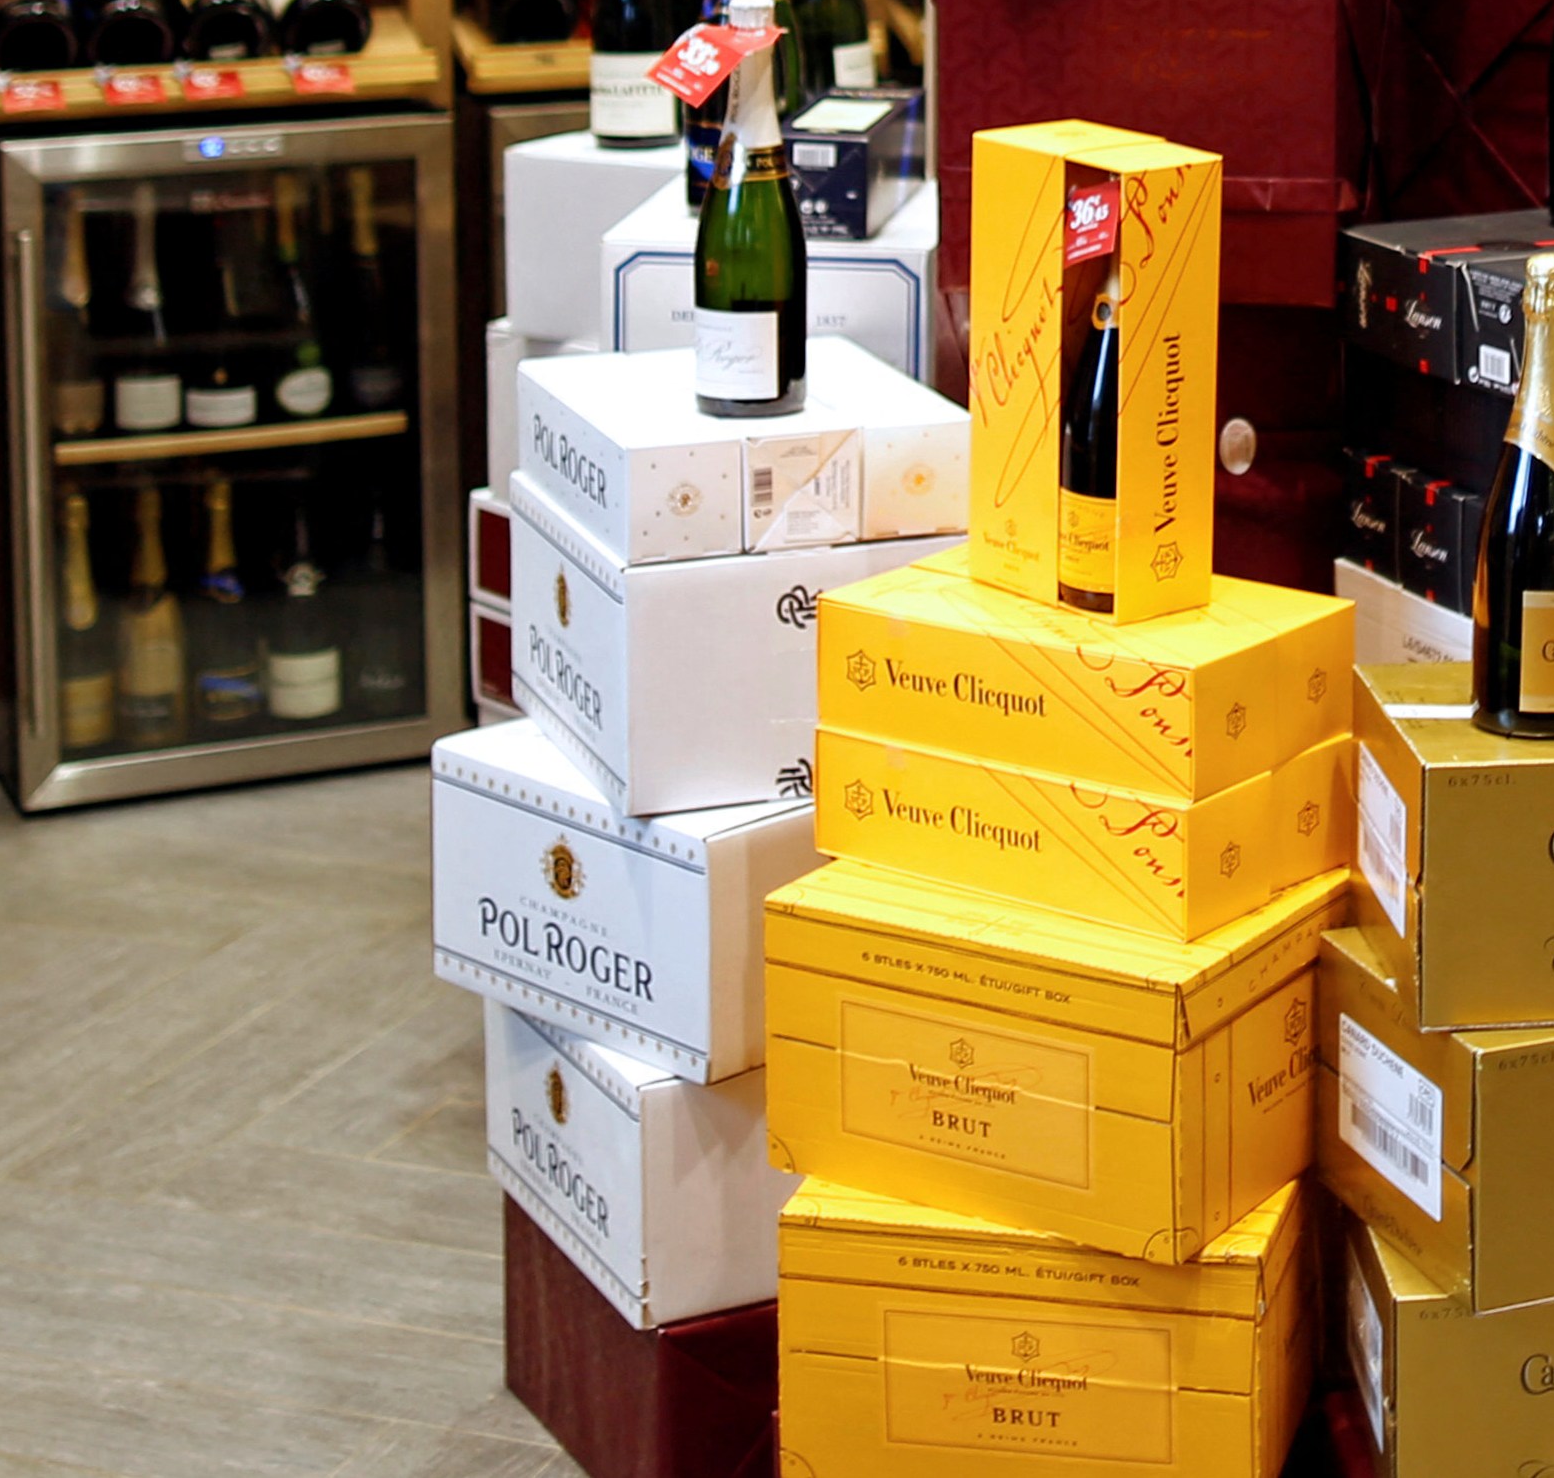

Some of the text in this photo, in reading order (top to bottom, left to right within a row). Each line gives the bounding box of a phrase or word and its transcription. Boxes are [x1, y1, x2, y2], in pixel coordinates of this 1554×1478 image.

[1154, 332, 1186, 534] Veuve Clicquot
[533, 414, 607, 510] POL ROGER
[529, 624, 603, 731] POL ROGER
[884, 657, 1048, 718] Veuve Clicquot
[882, 789, 1042, 853] Veuve Clicquot
[519, 896, 608, 938] CHAMPAGNE
[477, 897, 654, 1003] POL ROGER
[861, 952, 871, 962] 6
[874, 954, 912, 970] BTLES
[927, 964, 950, 978] 750
[1044, 989, 1071, 1004] BOX
[908, 1063, 1017, 1105] Veuve Clicquot
[1247, 1067, 1287, 1106] Veuve
[932, 1109, 992, 1138] BRUT
[512, 1107, 609, 1239] POL ROGER
[898, 1256, 907, 1266] 6
[912, 1257, 956, 1270] BTLES
[975, 1263, 1000, 1275] 750
[1111, 1274, 1141, 1288] BOX
[965, 1364, 1089, 1393] Veuve Clicquot
[992, 1407, 1062, 1428] BRUT
